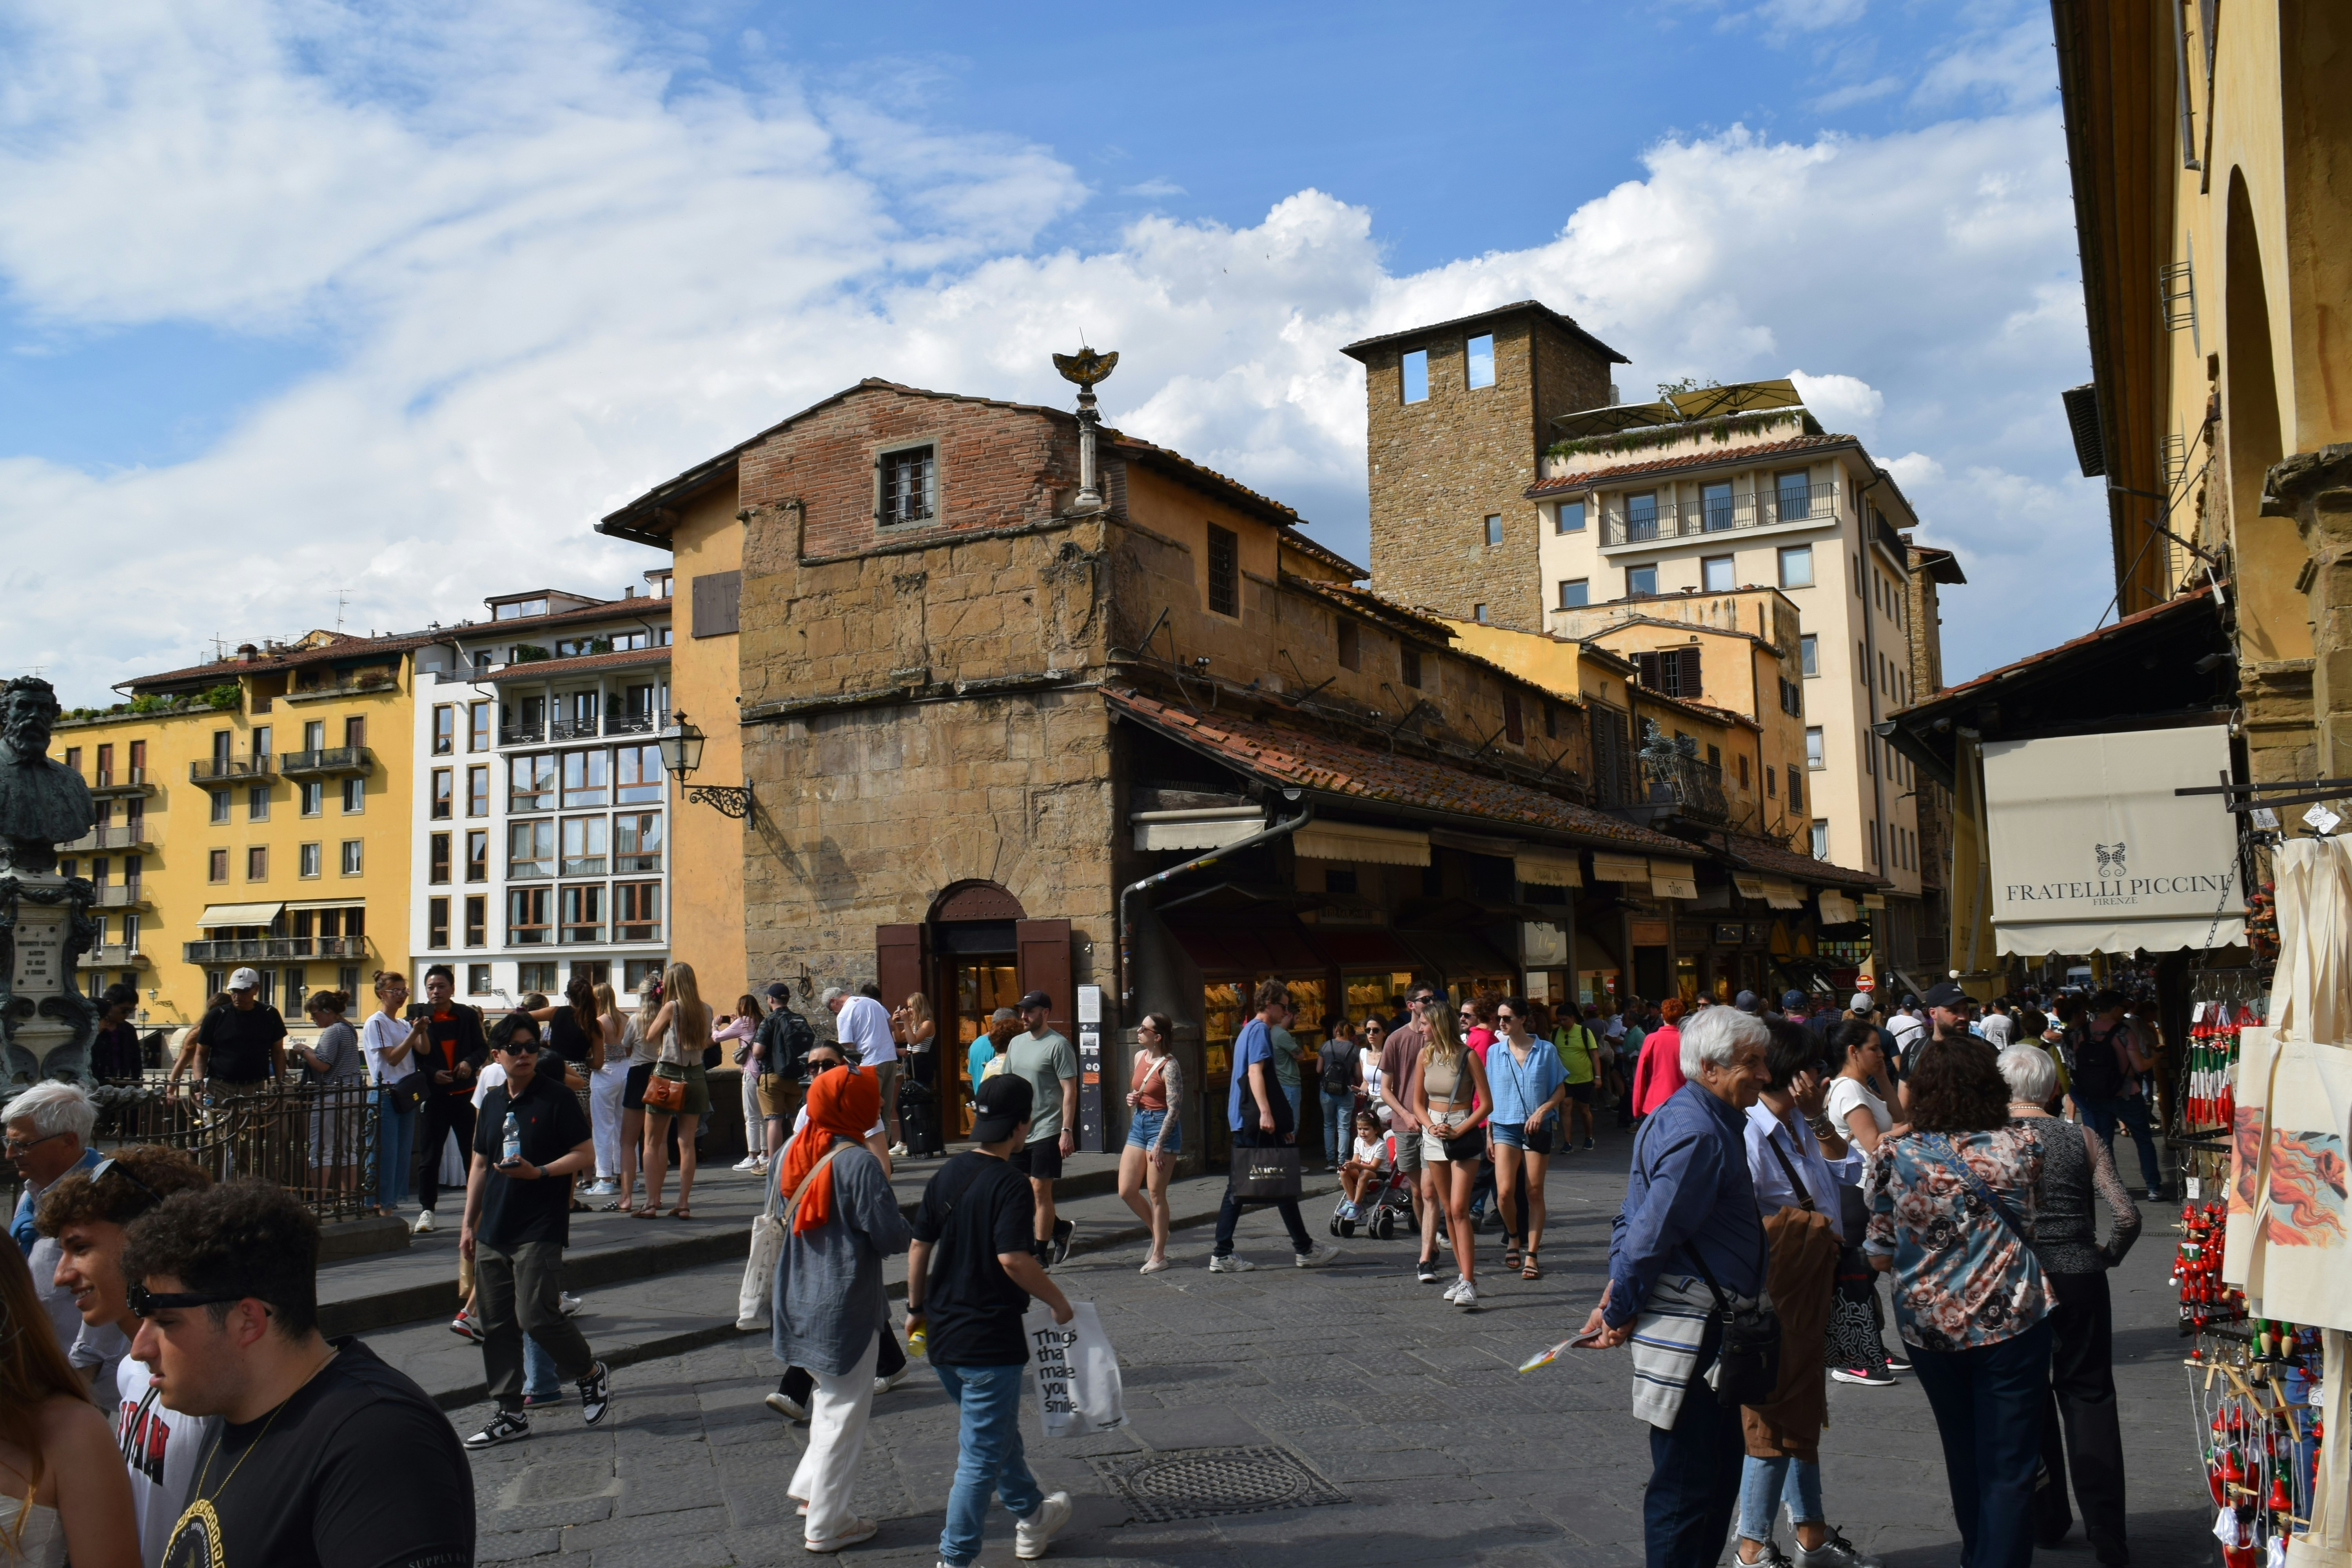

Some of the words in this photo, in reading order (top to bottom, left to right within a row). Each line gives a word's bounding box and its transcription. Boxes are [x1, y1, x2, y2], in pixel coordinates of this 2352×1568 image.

[2006, 880, 2123, 901] FRATELLI
[2129, 875, 2228, 895] PICCINI
[2093, 897, 2138, 906] FIRENZE
[1037, 1345, 1065, 1363] tha
[1042, 1383, 1068, 1400] you
[191, 1522, 205, 1537] SUPERIOR
[409, 1553, 452, 1568] SUPPLY
